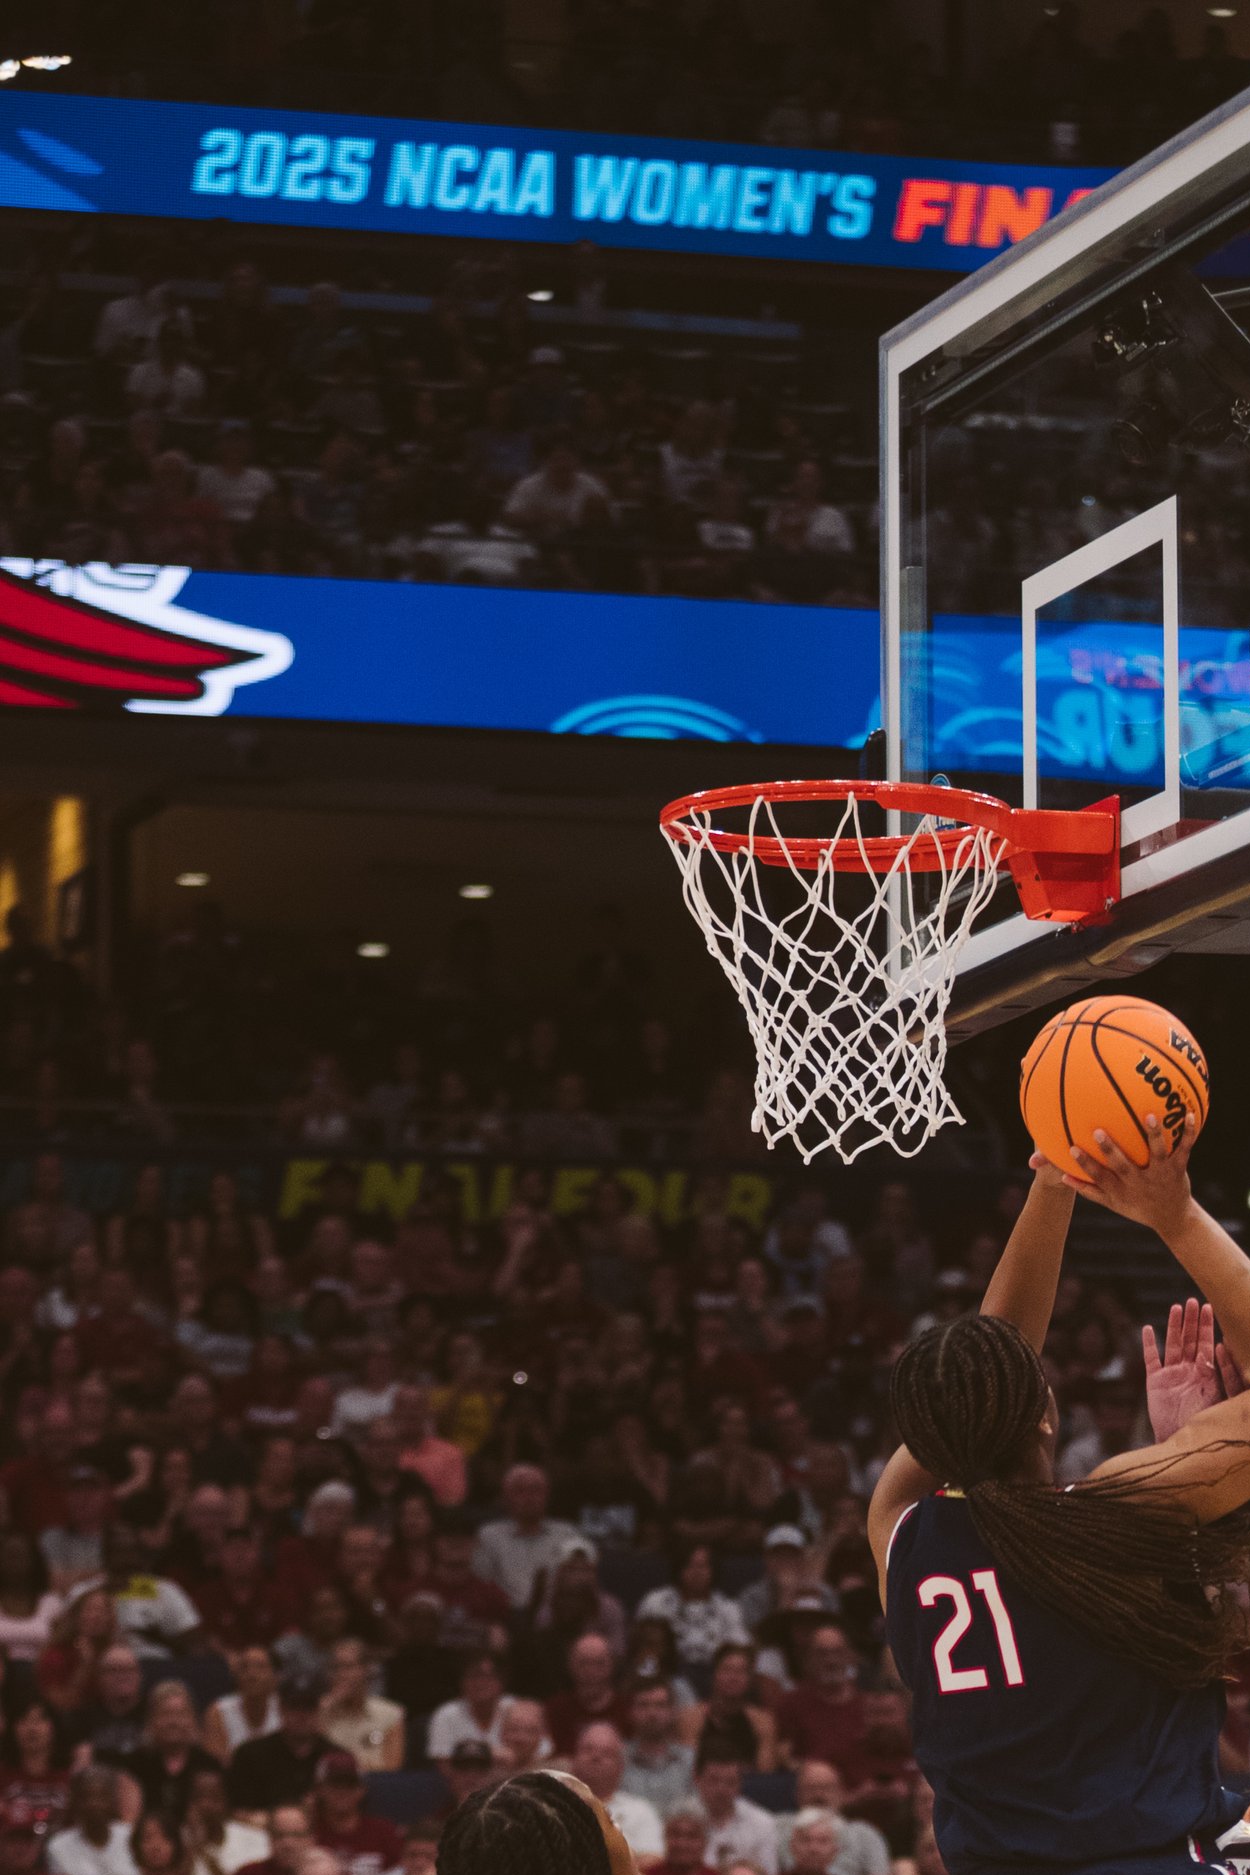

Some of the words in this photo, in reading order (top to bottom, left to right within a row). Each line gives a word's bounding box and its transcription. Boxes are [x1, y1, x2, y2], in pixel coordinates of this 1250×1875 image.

[191, 127, 376, 204] 2025
[383, 141, 557, 218] NCAA
[573, 154, 877, 240] WOMEN'S
[892, 177, 1100, 248] FIN
[917, 1567, 1026, 1695] 21
